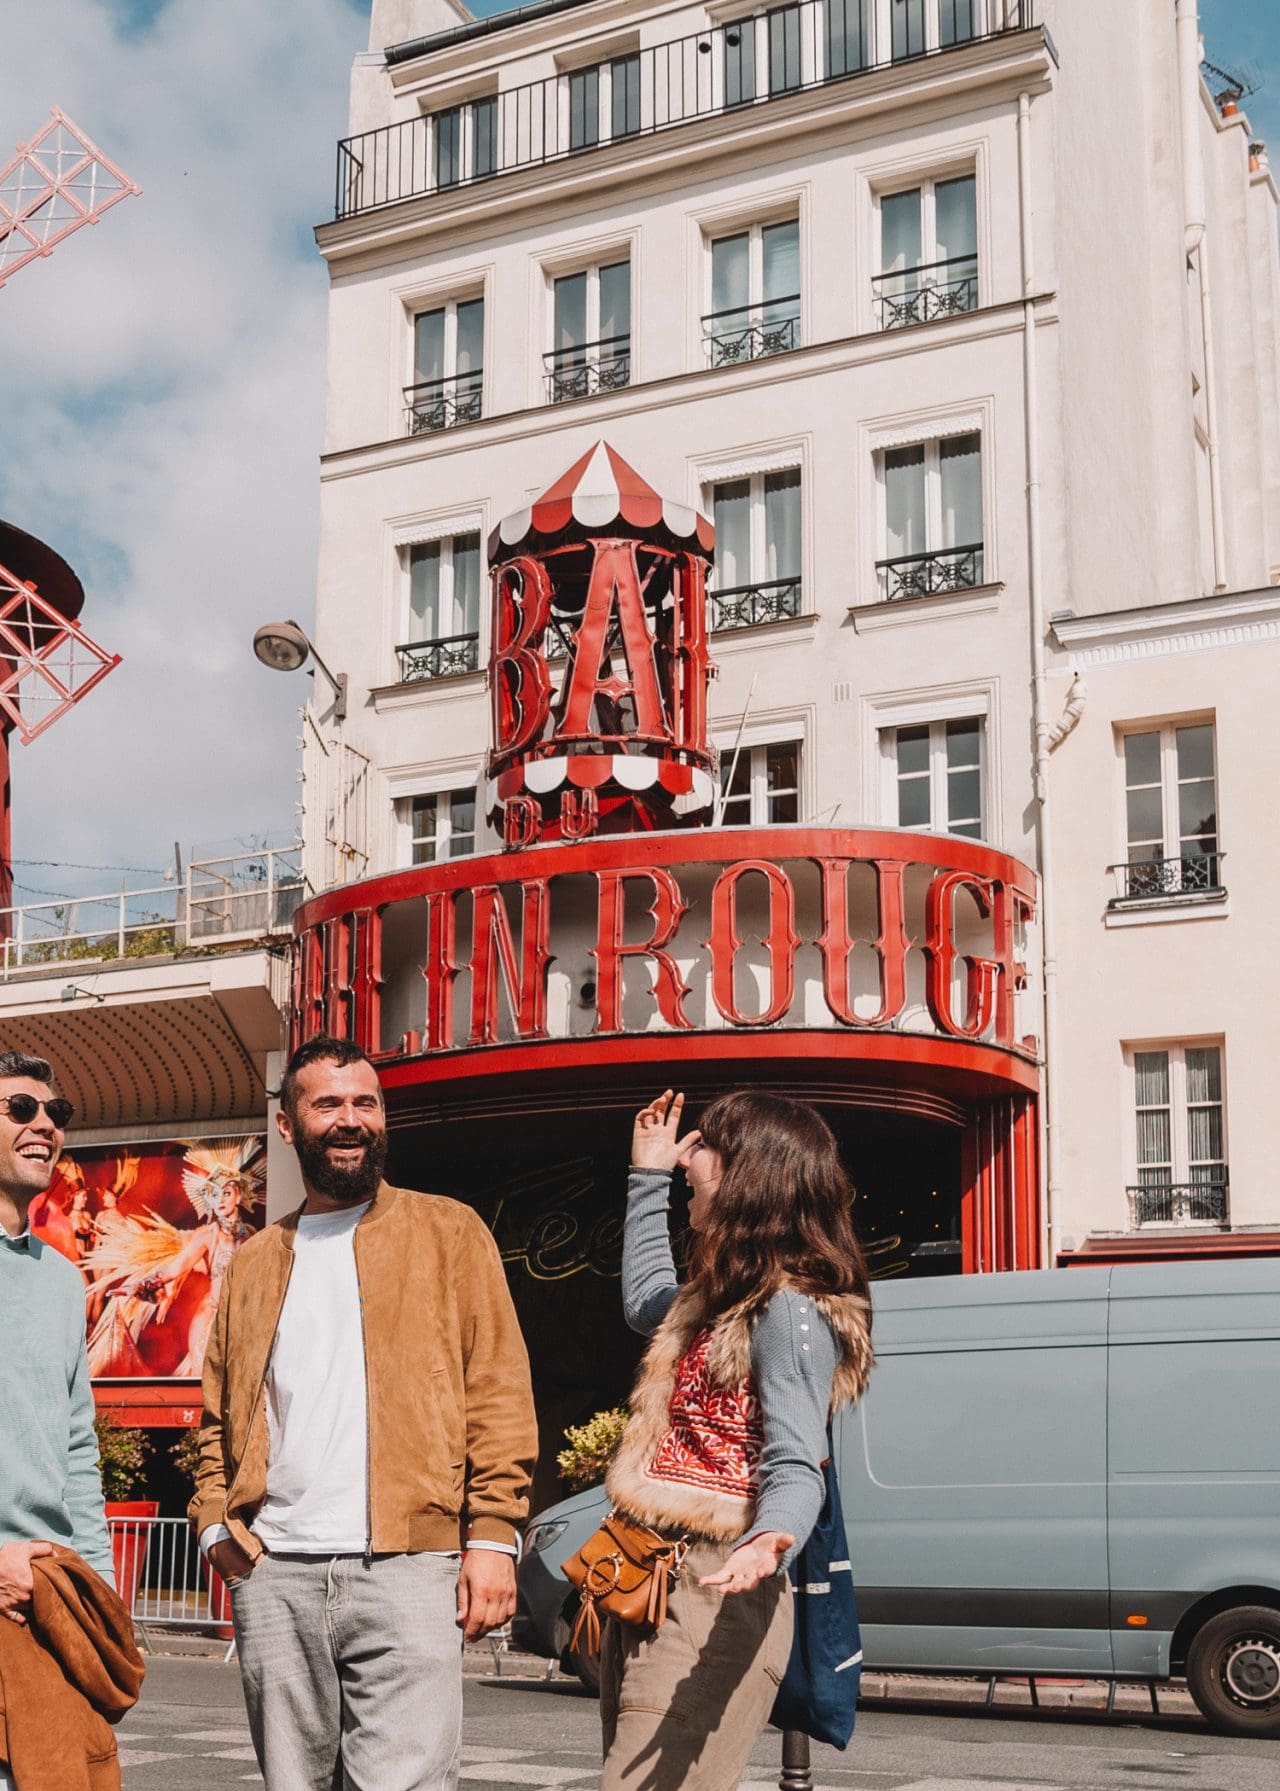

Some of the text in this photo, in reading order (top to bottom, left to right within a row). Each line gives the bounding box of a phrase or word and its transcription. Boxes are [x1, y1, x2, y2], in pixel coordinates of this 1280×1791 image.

[488, 538, 714, 758] BAL
[504, 788, 598, 845] DU
[588, 858, 1037, 1056] ROUGE
